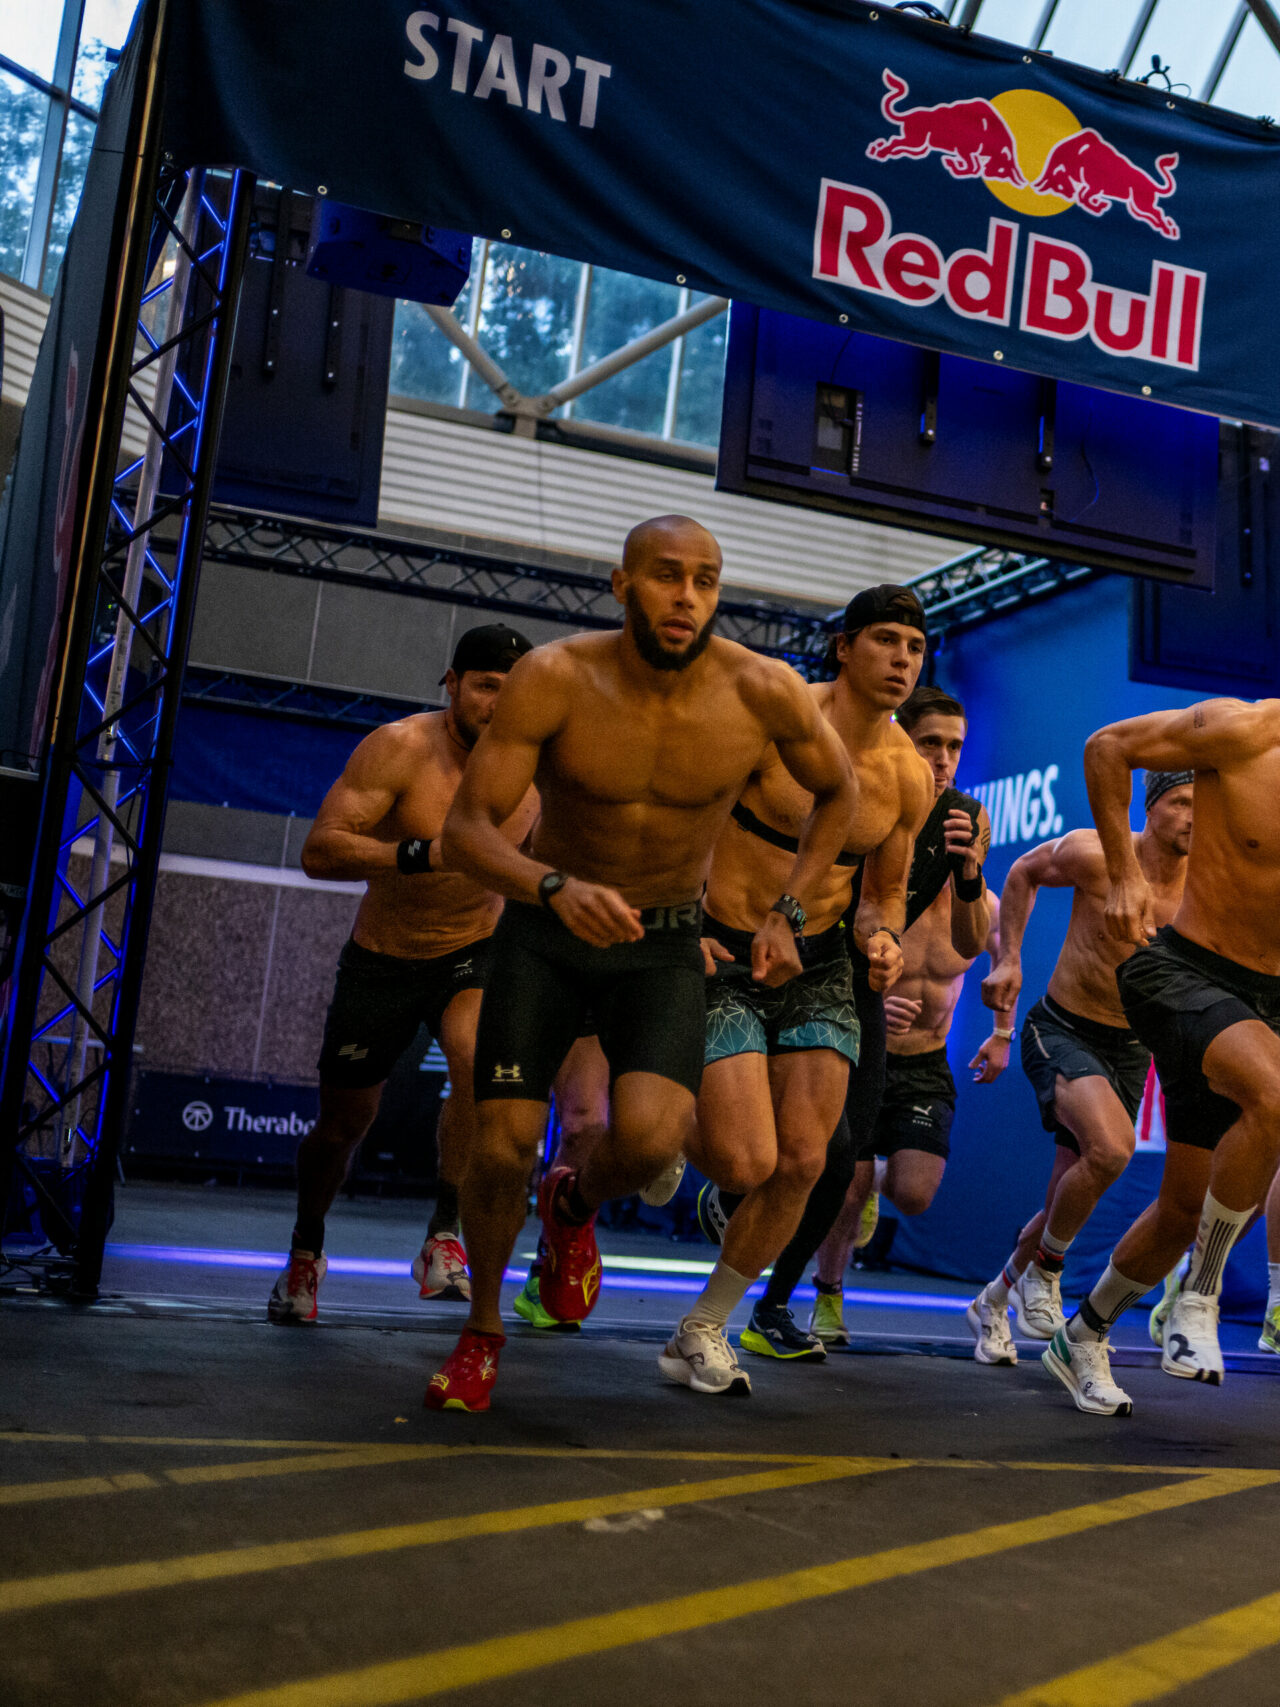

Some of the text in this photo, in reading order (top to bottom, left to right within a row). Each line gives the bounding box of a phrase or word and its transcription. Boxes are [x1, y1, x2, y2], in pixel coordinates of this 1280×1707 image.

[403, 10, 612, 129] START
[813, 178, 1207, 372] Red Bull
